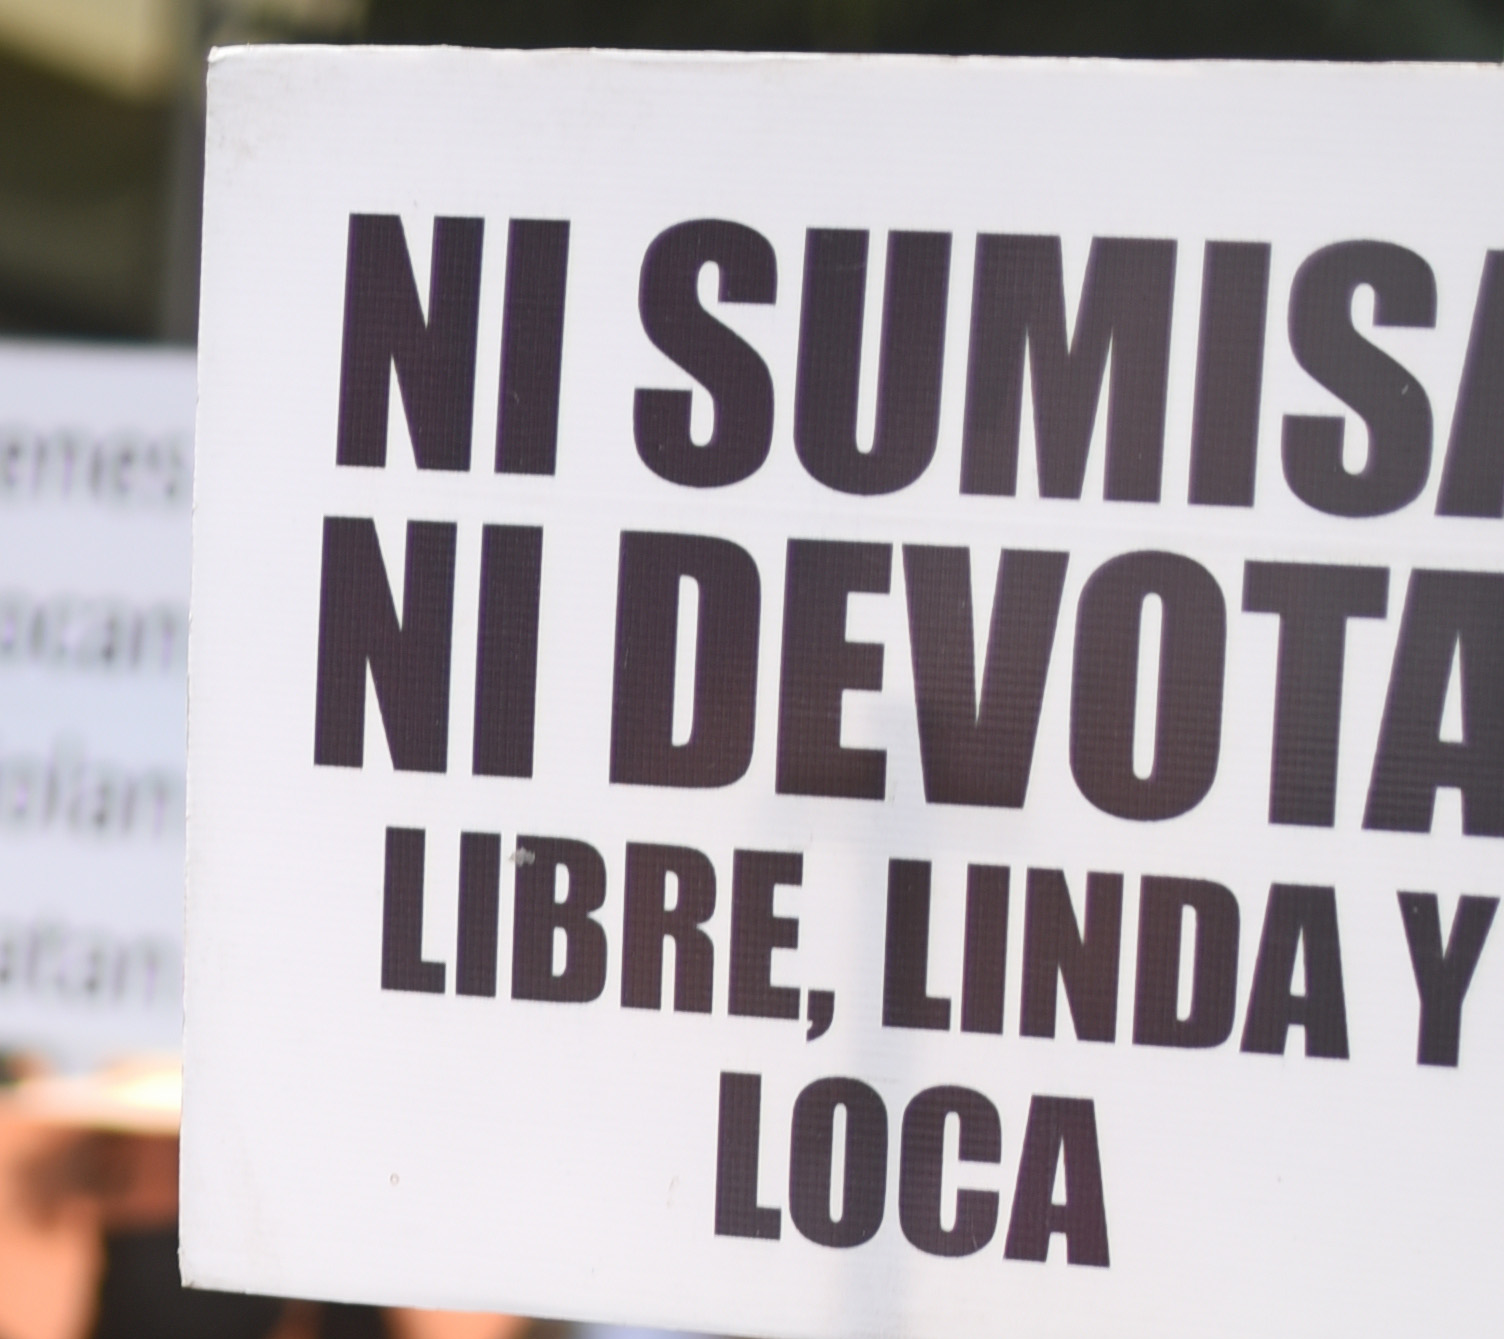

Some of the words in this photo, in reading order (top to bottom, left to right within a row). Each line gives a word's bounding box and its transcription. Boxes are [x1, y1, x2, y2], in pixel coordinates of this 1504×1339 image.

[335, 211, 571, 477] NI
[312, 514, 544, 781] NI
[380, 825, 837, 1042] LIBRE,
[879, 857, 1352, 1061] LINDA
[1396, 889, 1502, 1070] Y
[712, 1070, 1113, 1270] LOCA
